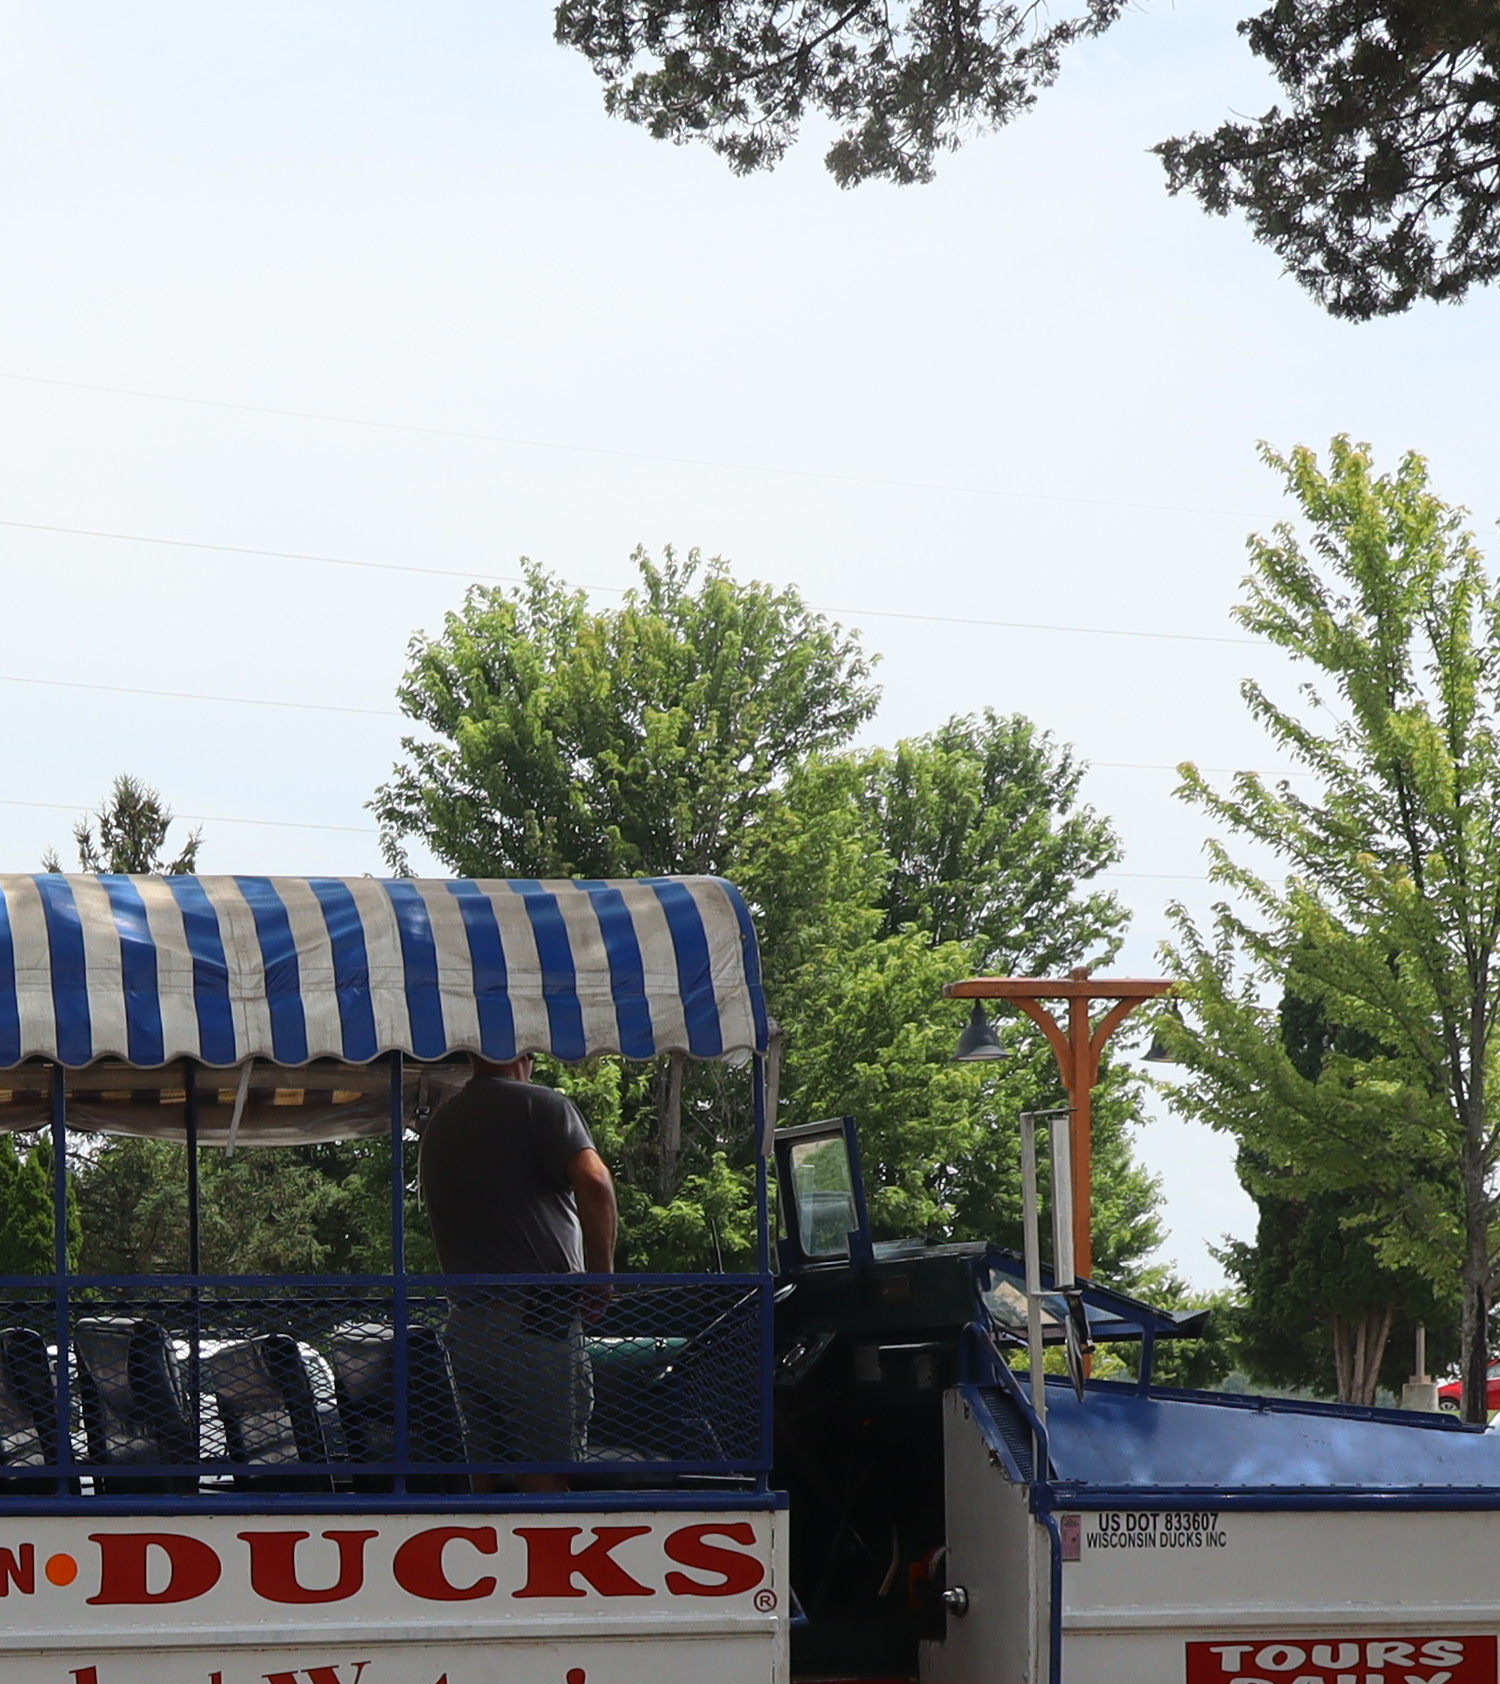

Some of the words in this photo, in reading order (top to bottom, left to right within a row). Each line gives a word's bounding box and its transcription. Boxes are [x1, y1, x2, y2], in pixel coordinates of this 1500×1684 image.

[1099, 1513, 1121, 1531] US
[1126, 1513, 1160, 1531] DOT
[1164, 1512, 1219, 1531] 833607
[1087, 1532, 1156, 1548] WISCONSIN
[1160, 1532, 1202, 1548] DUCKS
[1206, 1531, 1227, 1547] INC
[86, 1522, 765, 1606] DUCKS
[1209, 1640, 1464, 1672] TOURS
